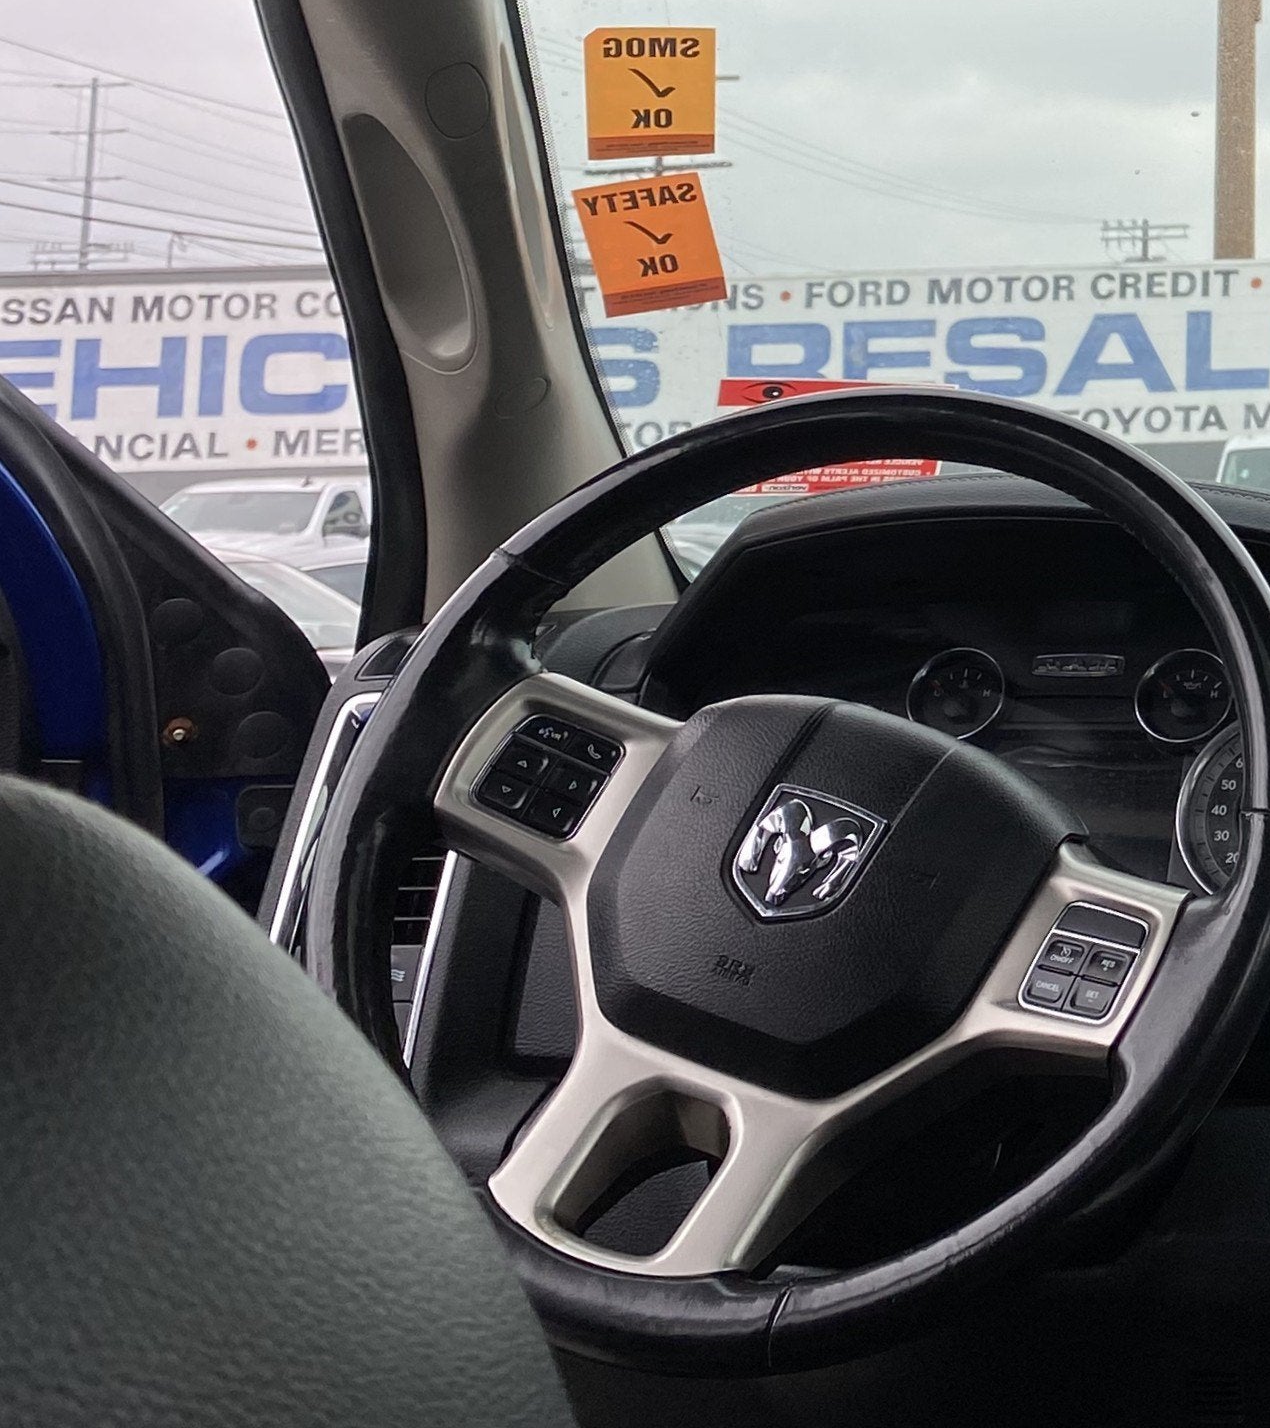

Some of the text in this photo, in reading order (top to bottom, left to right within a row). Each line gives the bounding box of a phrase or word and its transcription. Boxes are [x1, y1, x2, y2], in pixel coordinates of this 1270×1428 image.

[804, 278, 911, 310] FORD
[926, 275, 1075, 306] MOTOR
[1090, 268, 1240, 302] CREDIT
[130, 292, 279, 324] MOTOR
[1062, 402, 1228, 436] OYOTA
[1220, 779, 1237, 791] 50
[1211, 805, 1228, 816] 40
[1213, 830, 1230, 841] 30
